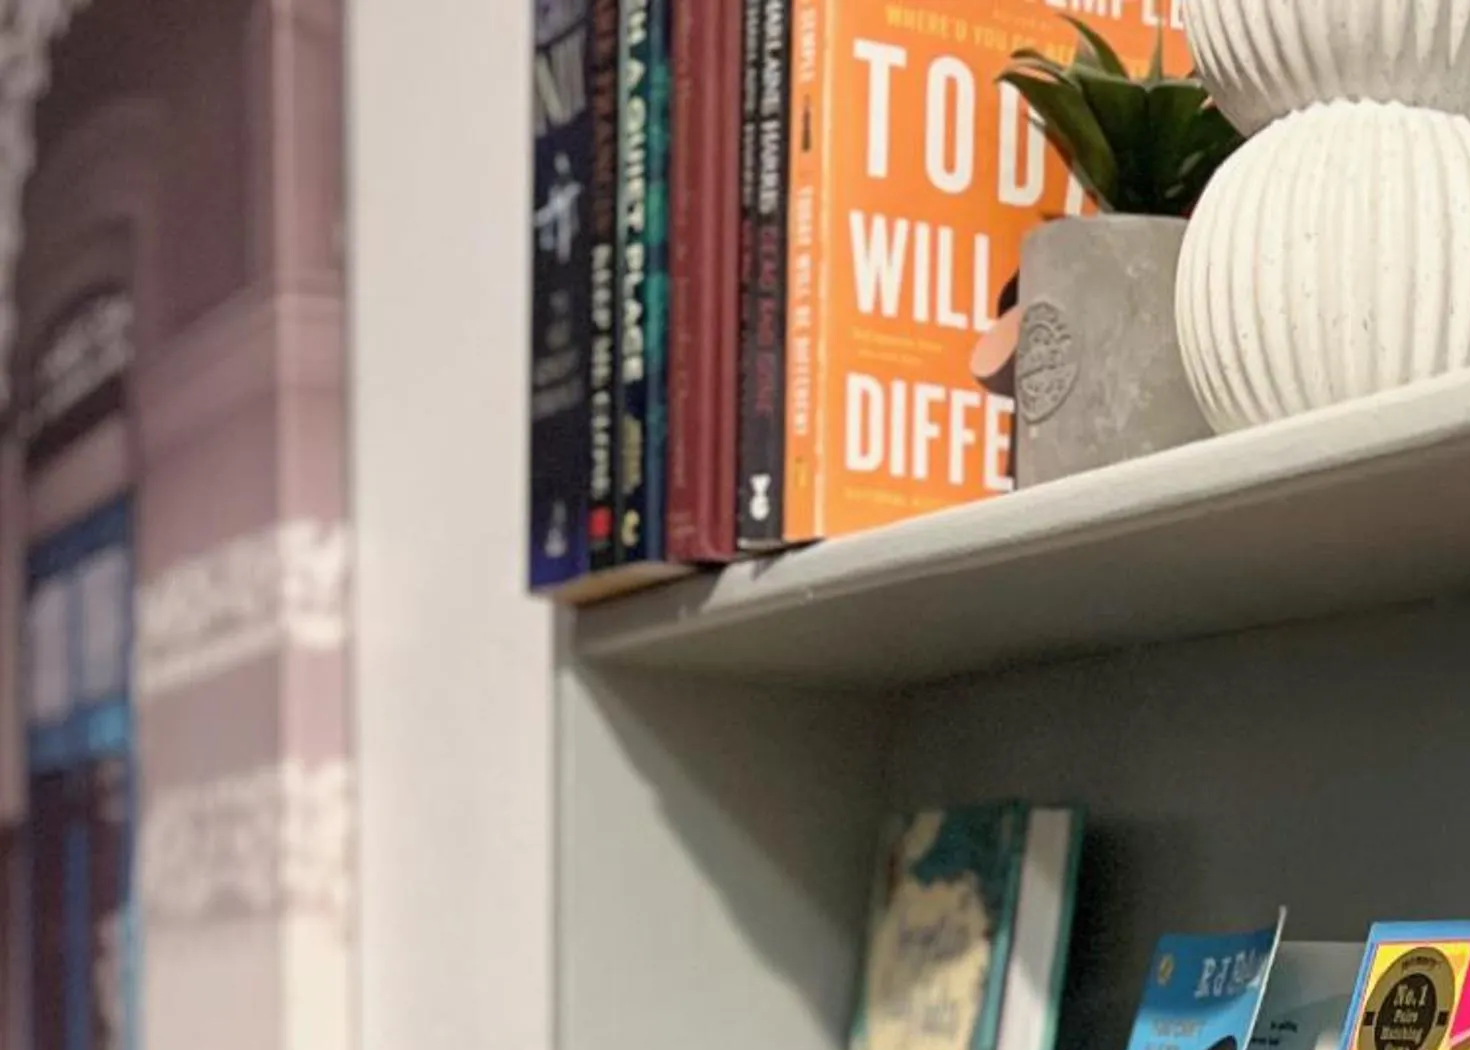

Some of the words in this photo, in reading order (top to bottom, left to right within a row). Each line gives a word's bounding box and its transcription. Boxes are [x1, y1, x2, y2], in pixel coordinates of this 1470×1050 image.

[623, 95, 646, 232] QUIET
[760, 119, 781, 214] HARRIS
[796, 185, 815, 246] TODAY
[622, 243, 645, 384] PLACE
[795, 252, 814, 299] WILL
[849, 211, 996, 333] WILL
[793, 336, 812, 436] DIFFERENT
